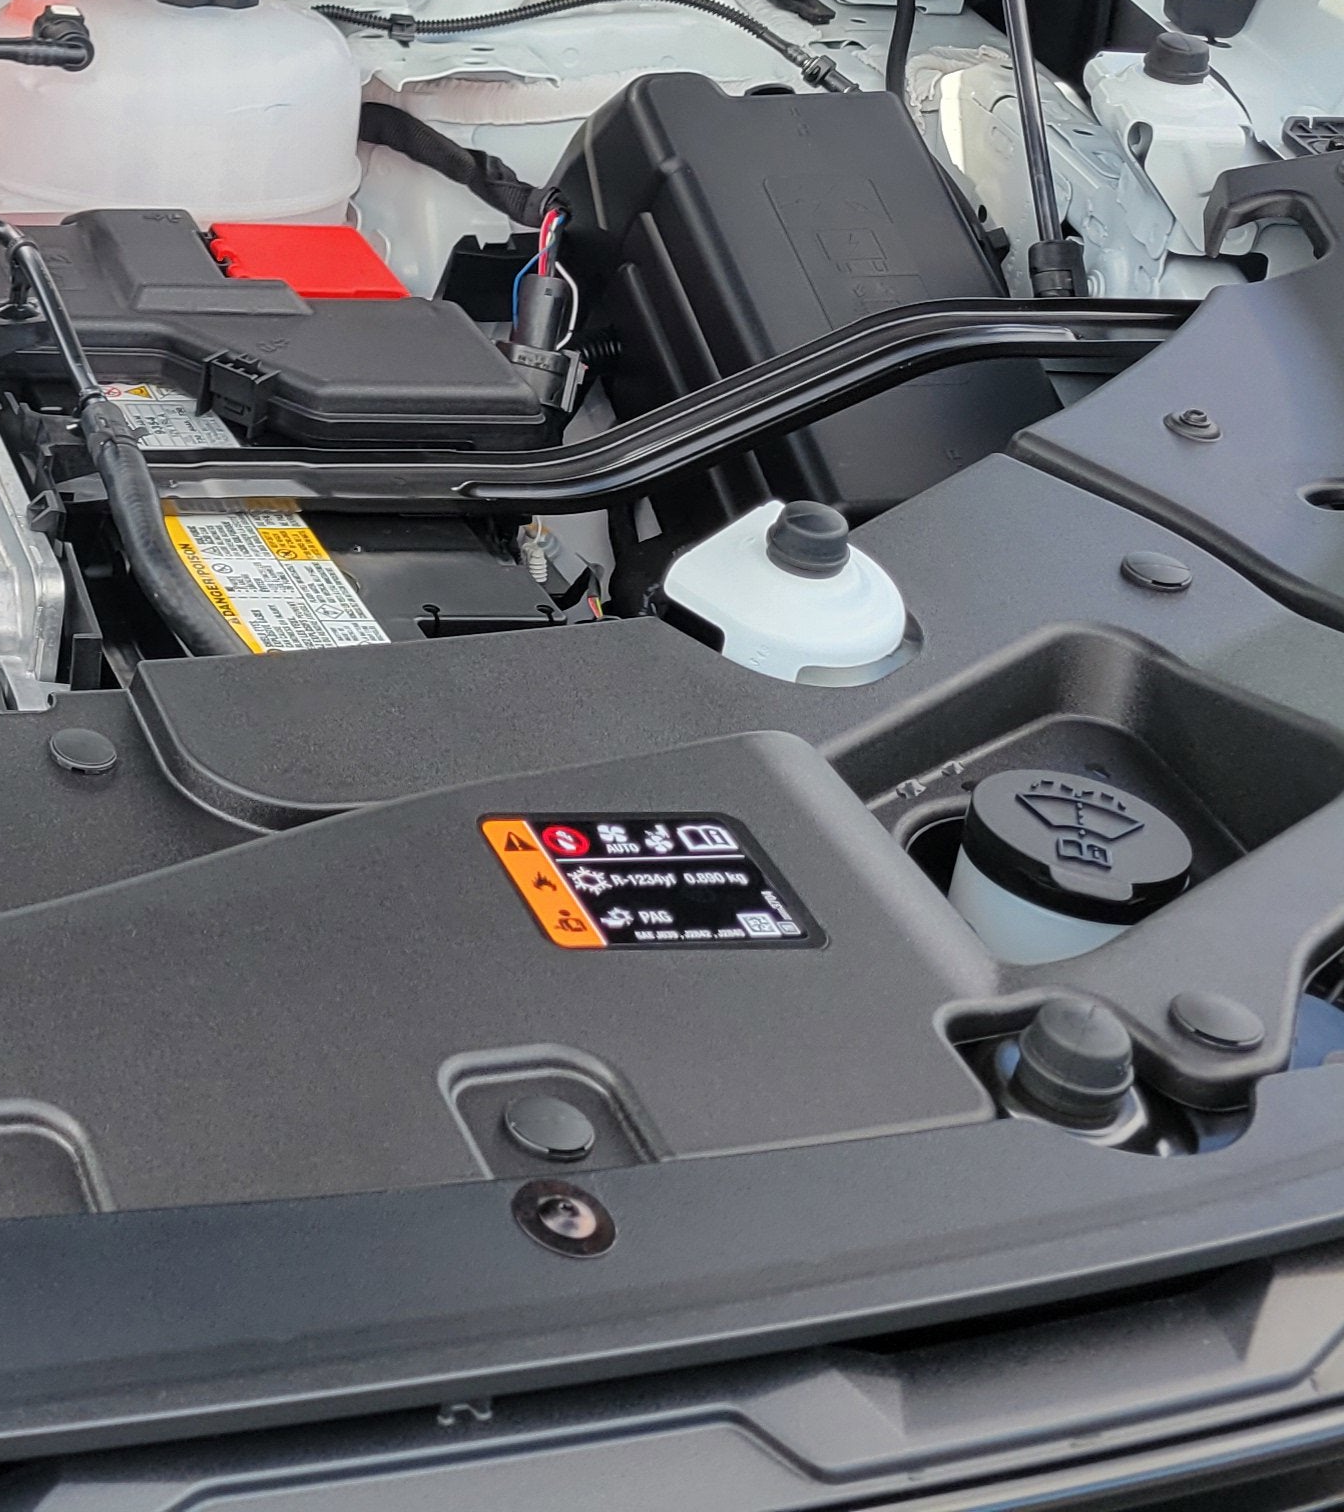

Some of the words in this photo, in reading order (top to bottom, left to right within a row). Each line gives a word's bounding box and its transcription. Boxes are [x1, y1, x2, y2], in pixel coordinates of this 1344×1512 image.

[606, 842, 640, 854] AUTO
[610, 874, 677, 887] R-1234yf
[725, 872, 749, 886] kg
[638, 910, 673, 925] PAG
